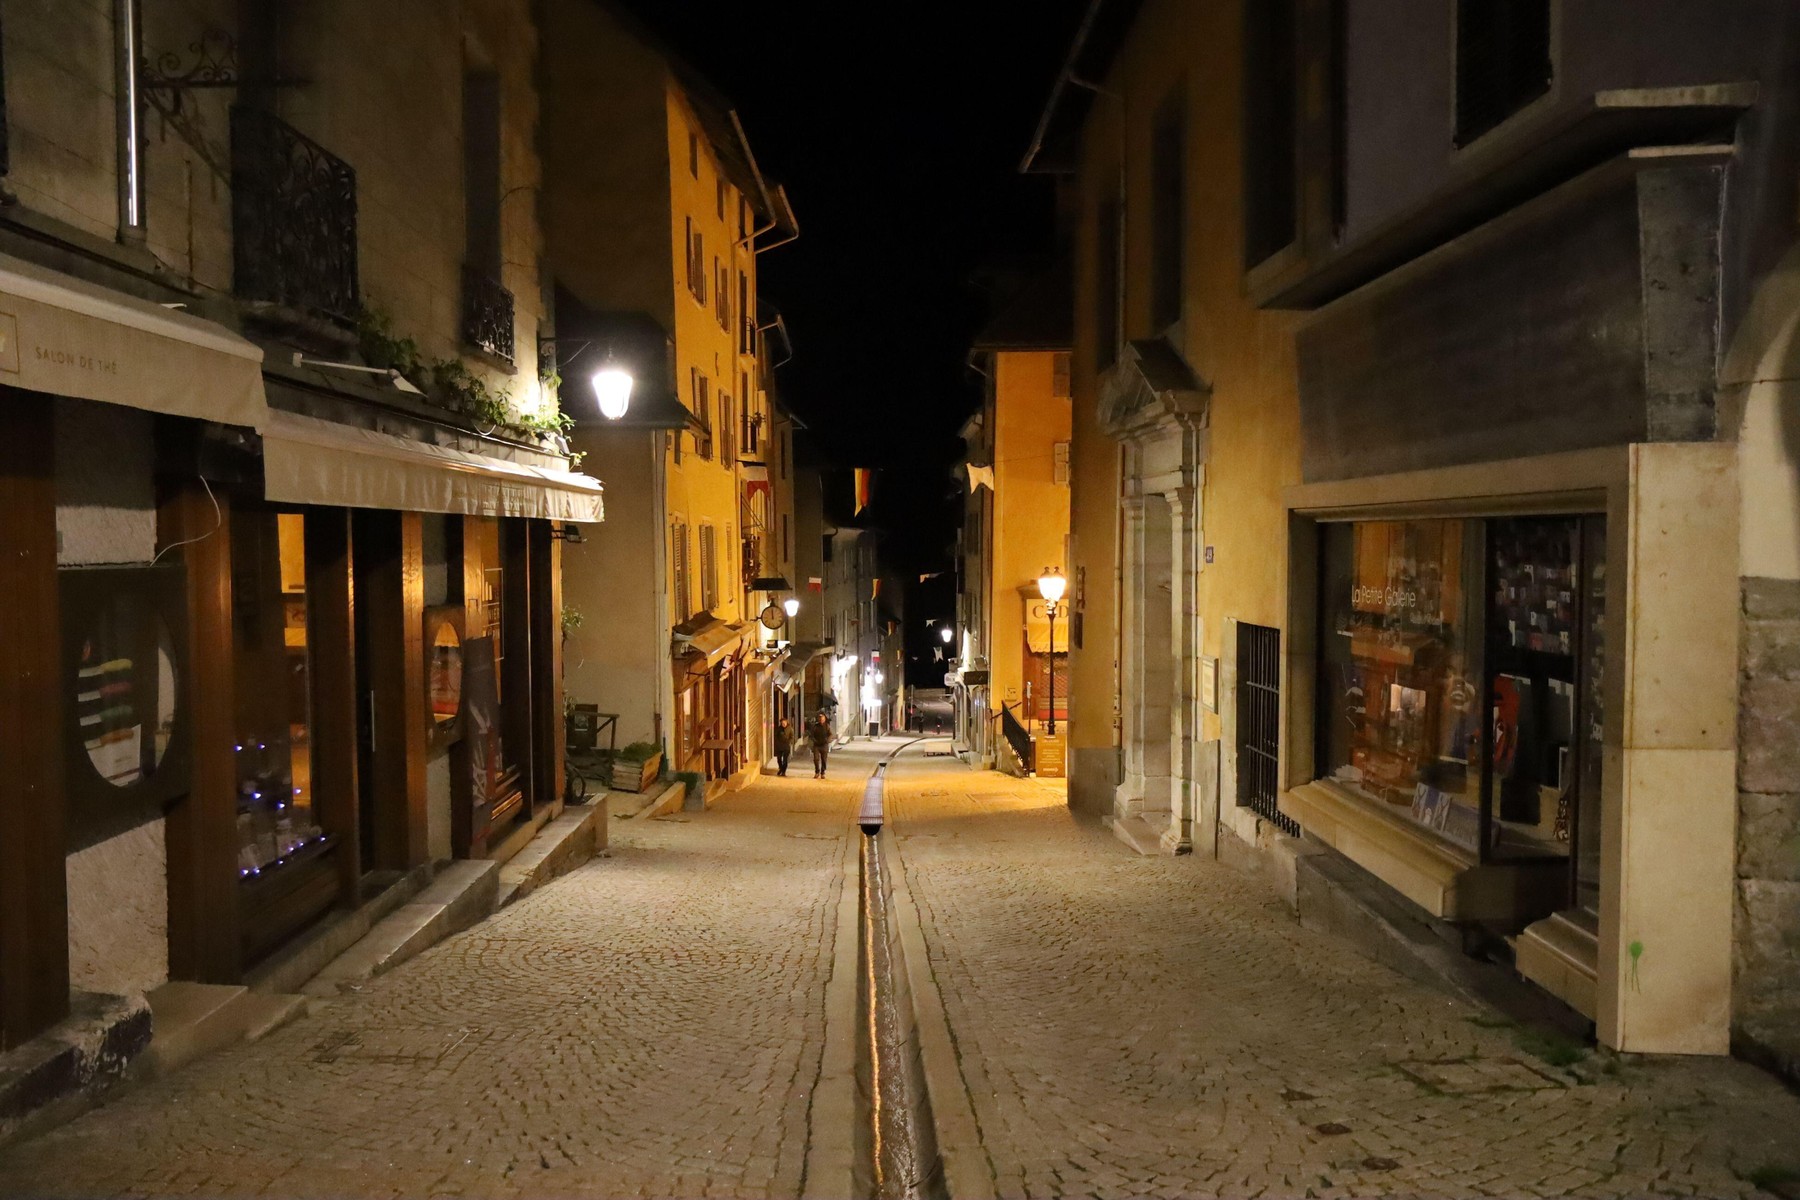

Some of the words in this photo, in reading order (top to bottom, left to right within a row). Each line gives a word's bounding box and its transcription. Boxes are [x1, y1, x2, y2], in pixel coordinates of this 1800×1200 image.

[35, 346, 74, 367] SALON
[80, 356, 93, 370] DE
[1352, 584, 1360, 604] La
[1361, 585, 1383, 604] Petite
[1384, 586, 1416, 608] Galerie
